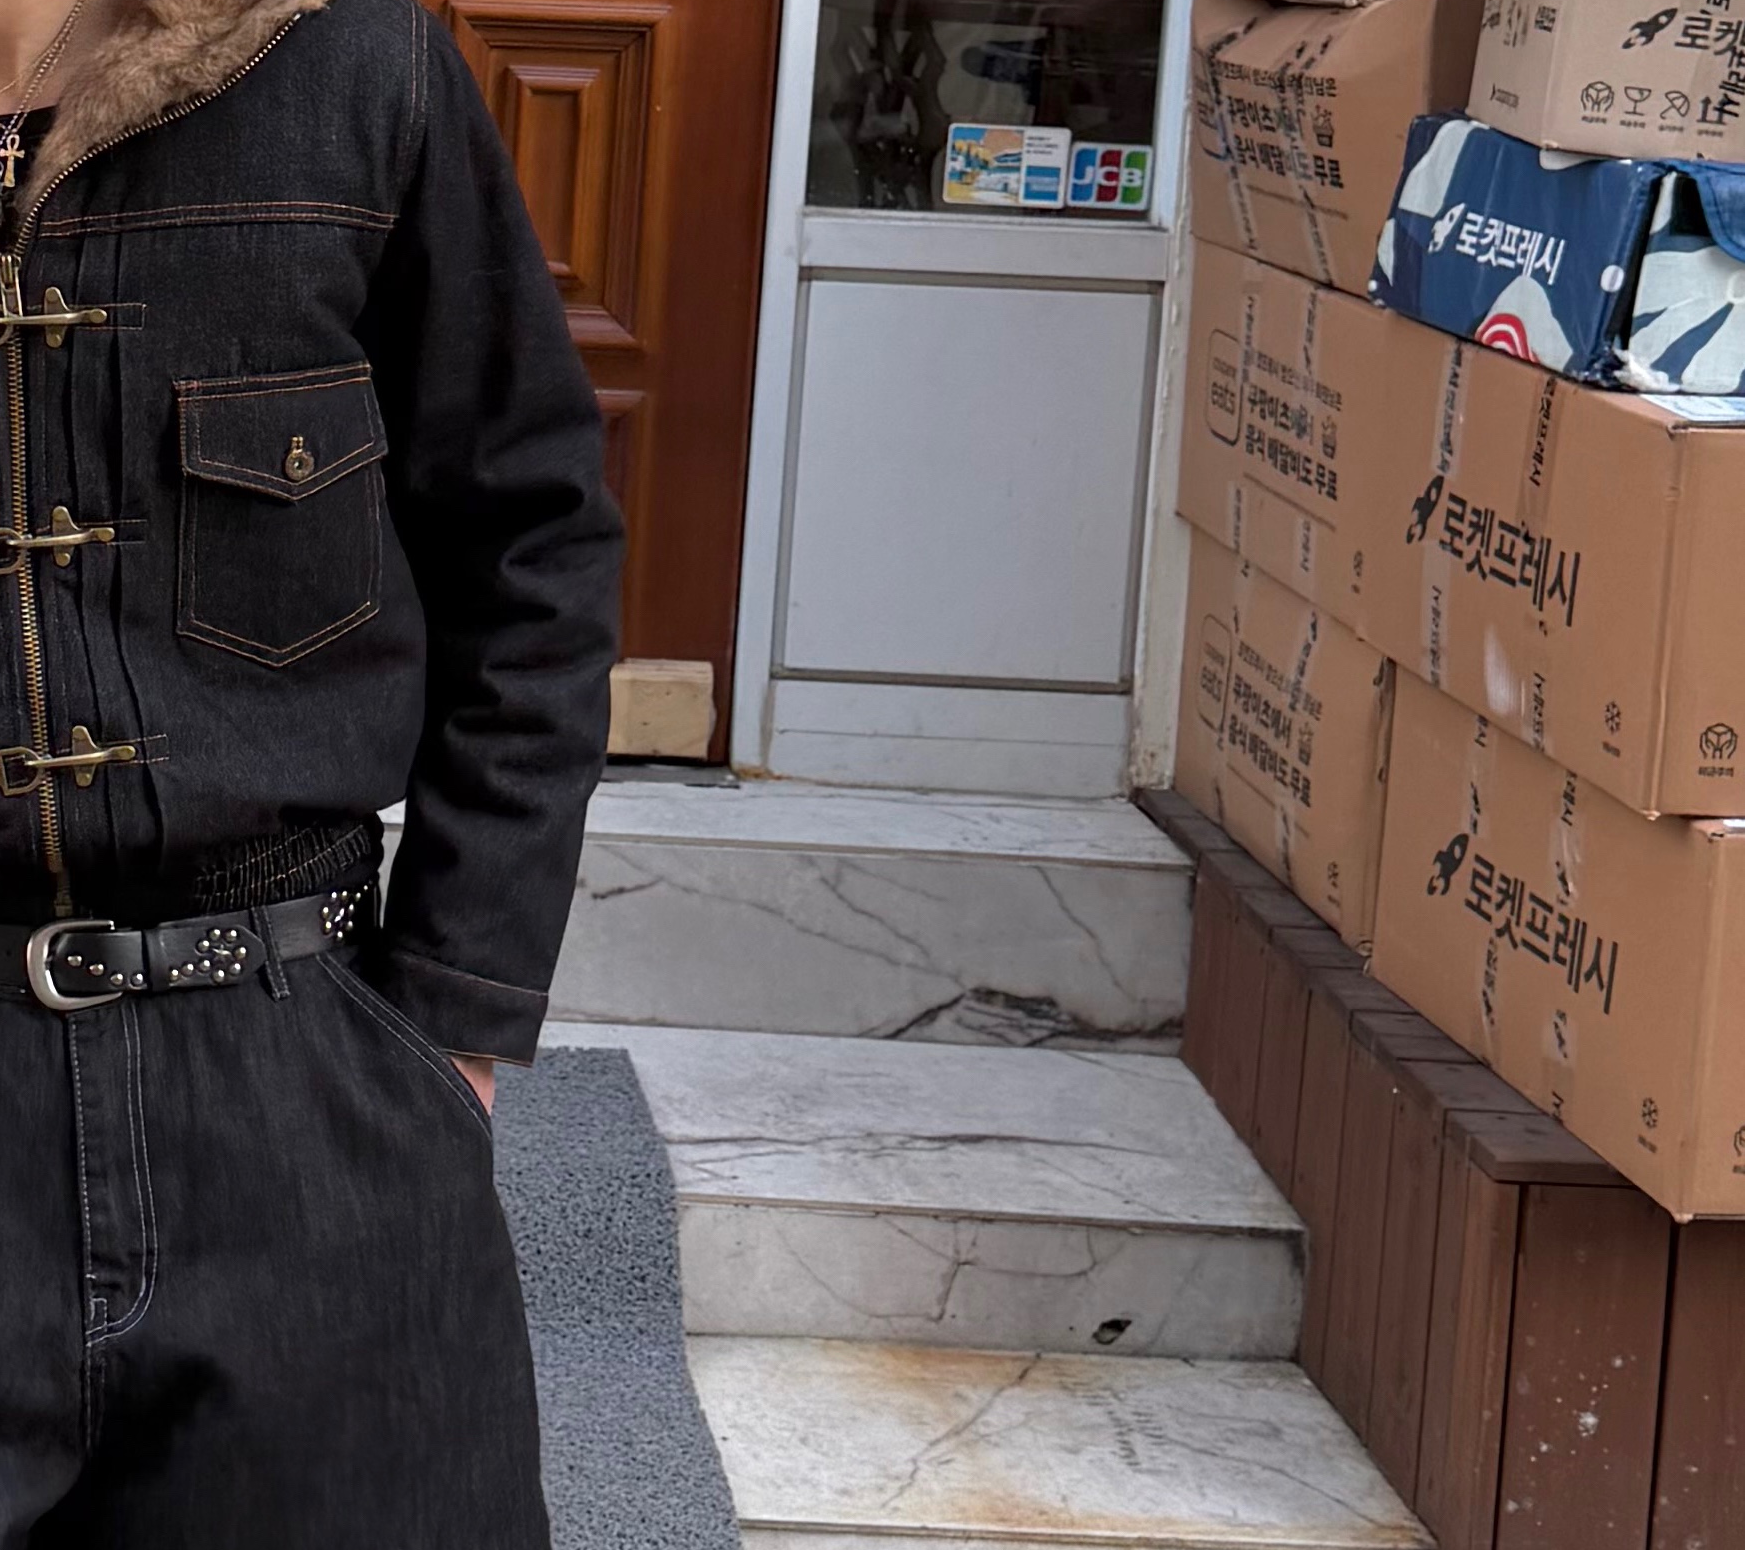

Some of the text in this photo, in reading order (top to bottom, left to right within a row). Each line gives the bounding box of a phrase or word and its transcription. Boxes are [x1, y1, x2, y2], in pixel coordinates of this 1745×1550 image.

[1455, 211, 1566, 286] 로켓프레시
[1438, 492, 1581, 627] 로켓프레시
[1464, 853, 1618, 1015] 로켓프레시
